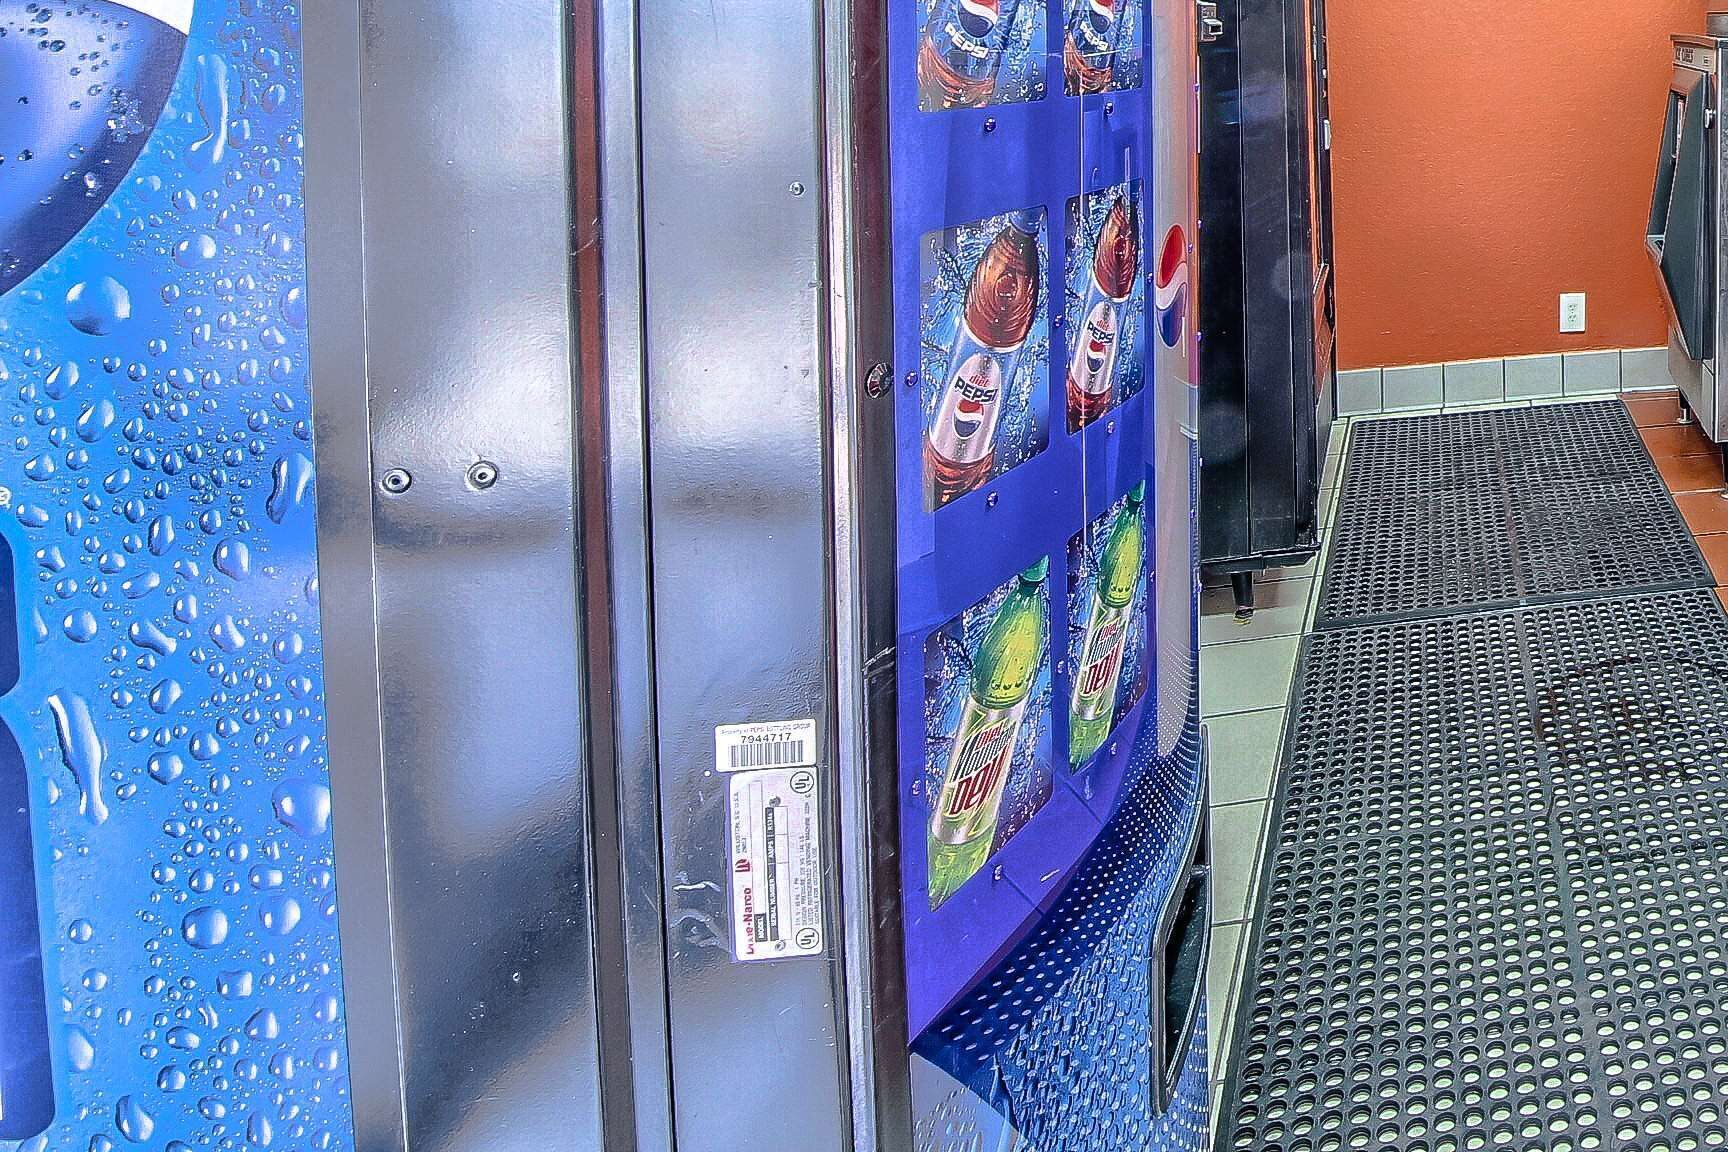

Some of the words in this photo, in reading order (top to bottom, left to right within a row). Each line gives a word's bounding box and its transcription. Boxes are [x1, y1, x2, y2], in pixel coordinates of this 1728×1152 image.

[944, 22, 990, 60] PEPSI
[1079, 23, 1110, 52] PEPSI
[1086, 322, 1116, 344] PEPSI
[1096, 319, 1112, 332] diet
[953, 376, 998, 404] PEPSI
[968, 374, 990, 390] diet
[740, 732, 792, 744] 7944717
[768, 878, 778, 908] NUMBER
[756, 916, 766, 941] MODEL
[769, 908, 778, 928] SERIAL
